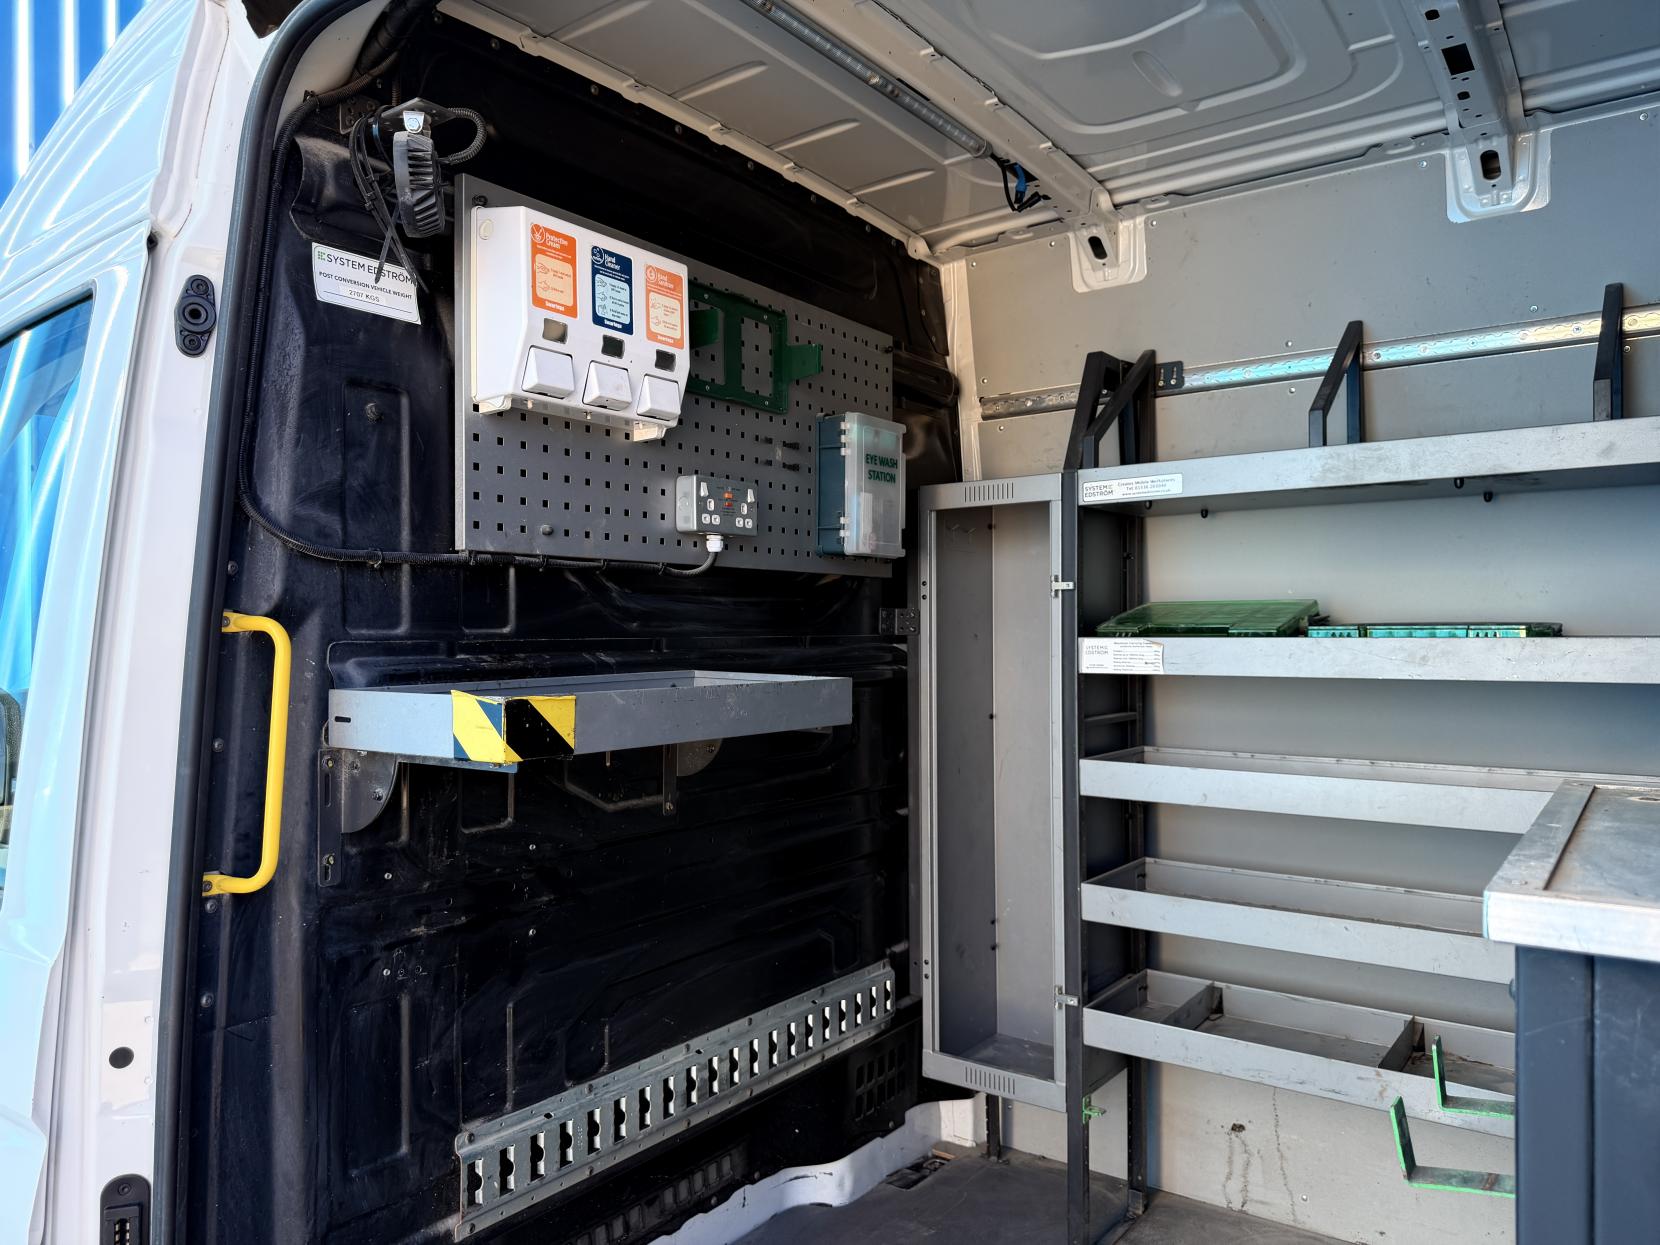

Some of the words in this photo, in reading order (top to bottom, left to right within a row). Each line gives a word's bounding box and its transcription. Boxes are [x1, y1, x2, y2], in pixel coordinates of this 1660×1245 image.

[546, 239, 561, 250] Cream
[326, 253, 366, 272] SYSTEM
[604, 259, 621, 271] Cleaner
[605, 253, 616, 263] Hand
[319, 271, 333, 279] POST
[334, 275, 370, 289] CONVERSION
[370, 284, 392, 295] VEHICLE
[392, 291, 413, 300] WEIGHT
[348, 289, 364, 298] 2707
[365, 294, 380, 303] KGS
[865, 453, 878, 466] EYE
[878, 455, 898, 470] WASH
[867, 469, 896, 484] STATION
[1084, 484, 1107, 492] SYSTEM
